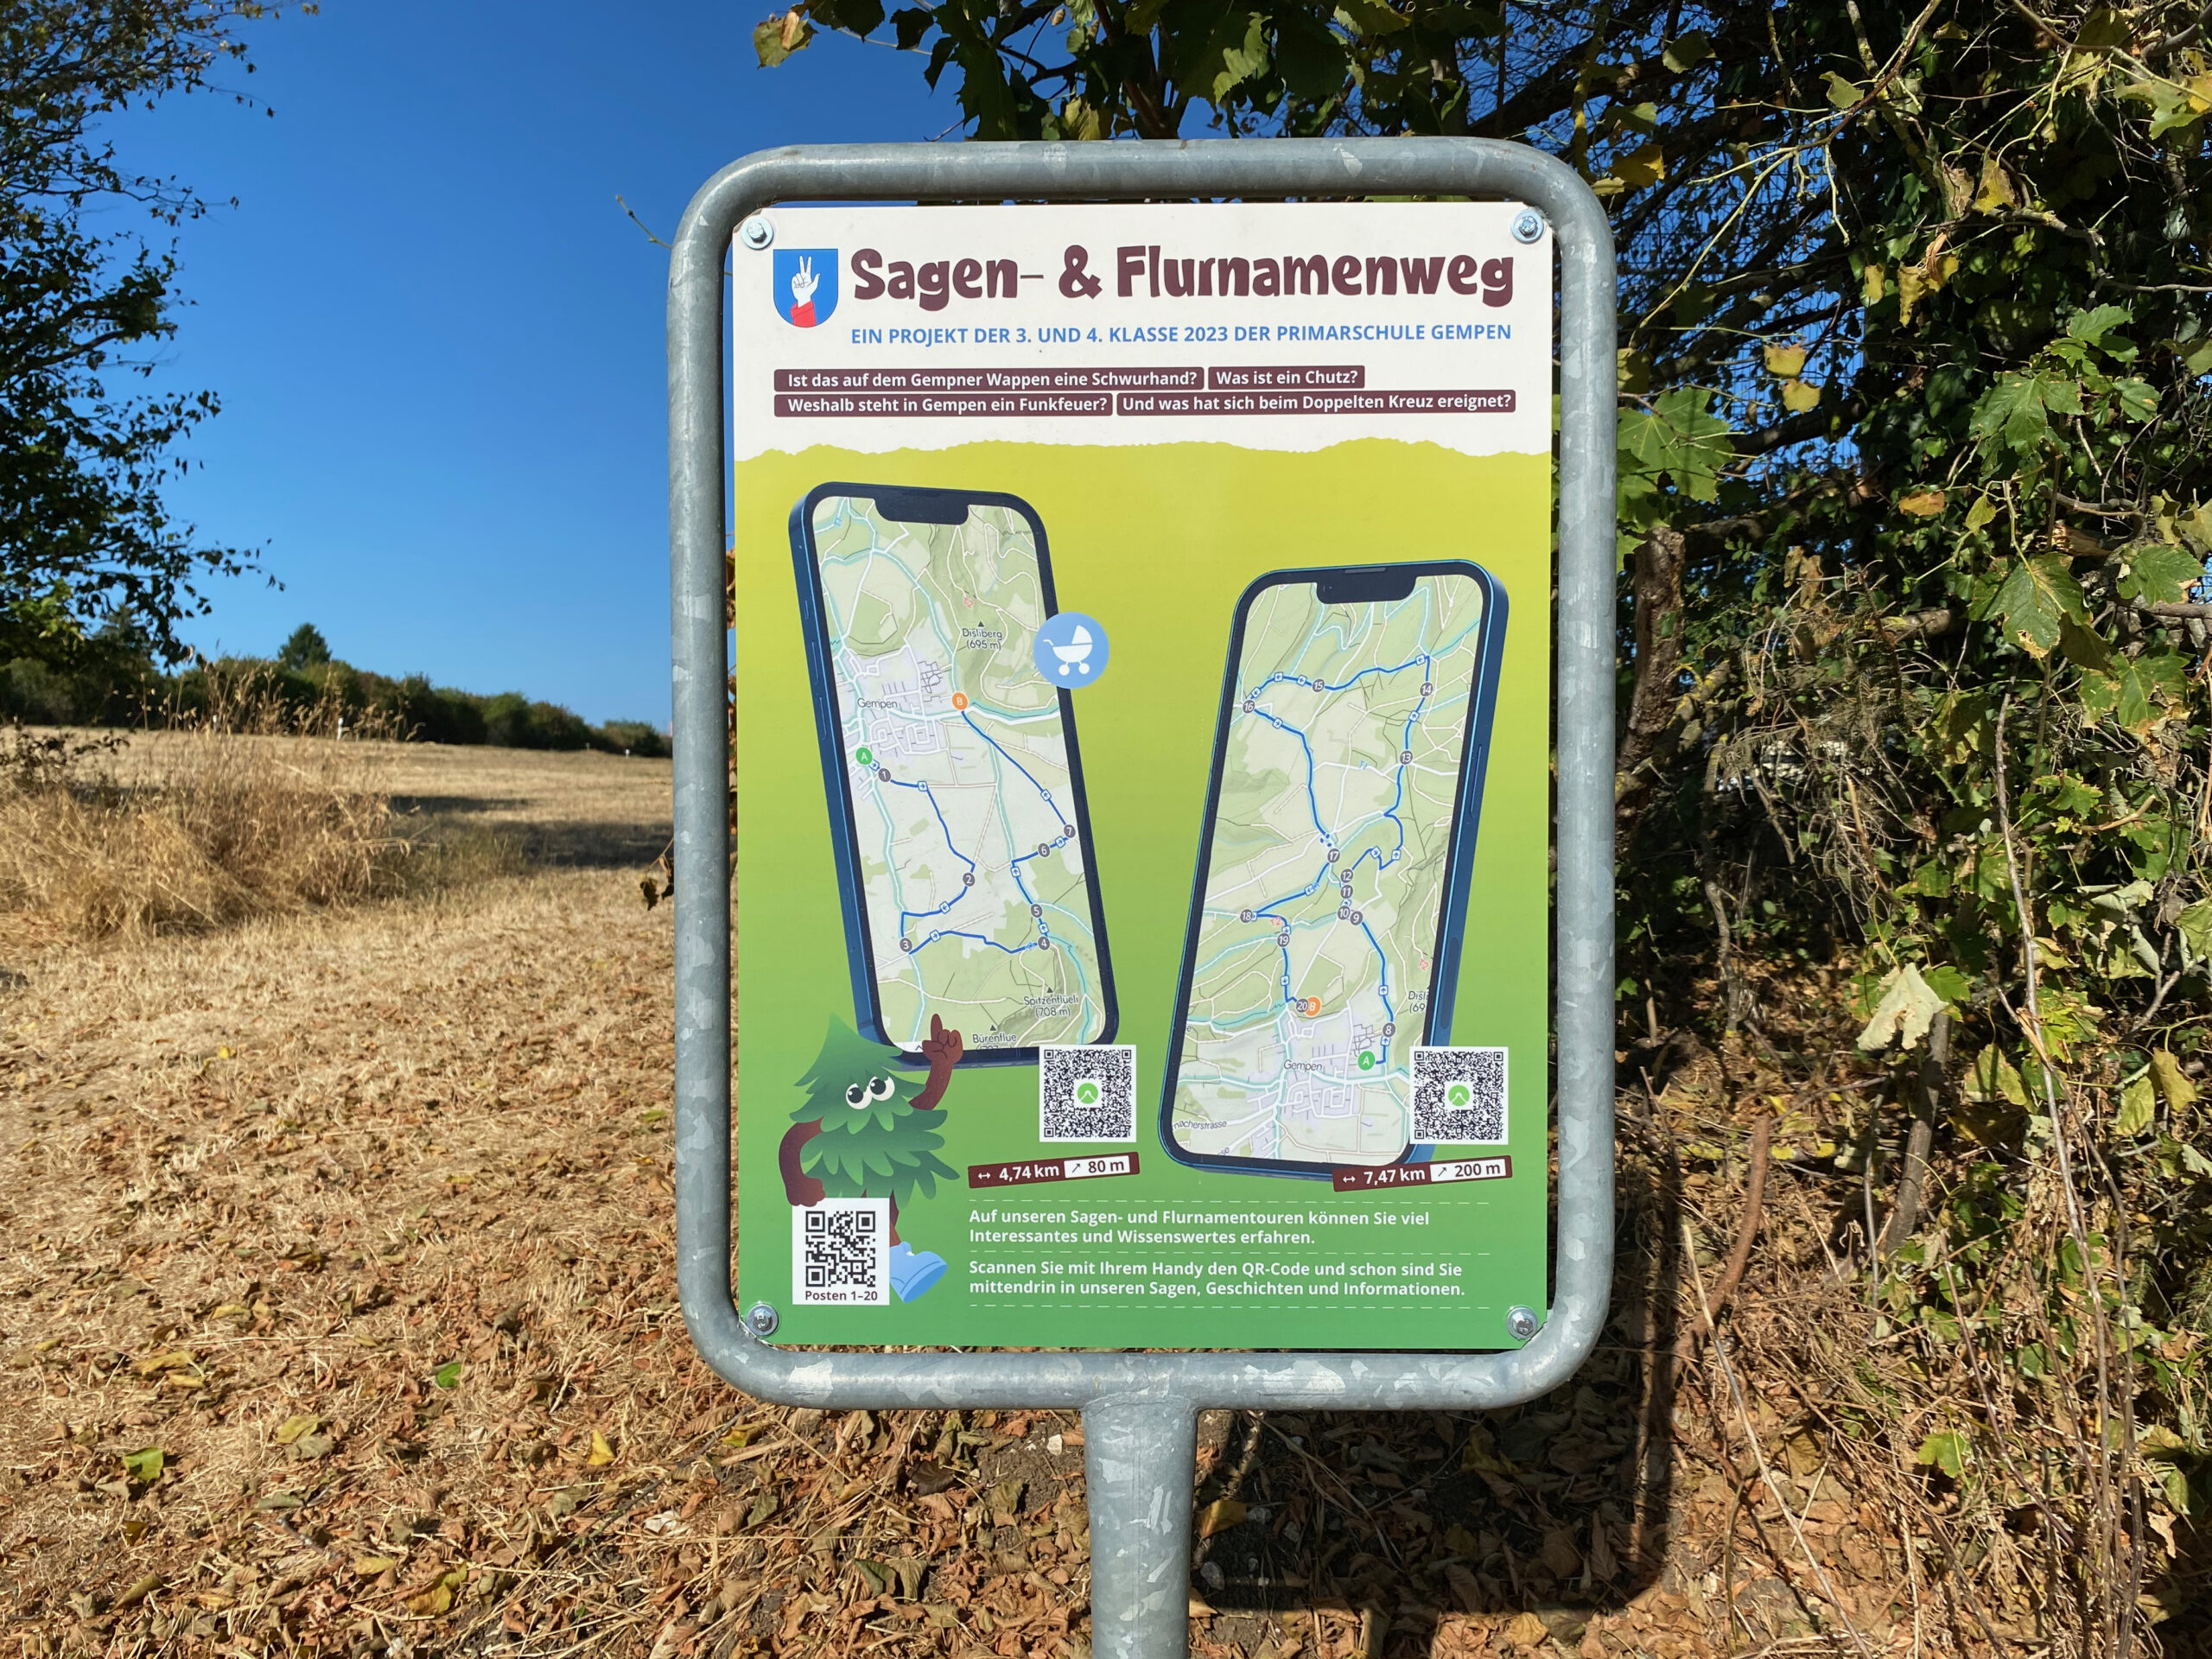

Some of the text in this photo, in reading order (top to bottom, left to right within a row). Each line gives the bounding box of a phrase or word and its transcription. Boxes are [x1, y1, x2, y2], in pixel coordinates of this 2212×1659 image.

[851, 245, 1514, 311] Sagen- & Flurnamenweg
[852, 324, 1510, 347] EIN PROJEKT DER 3. UND 4. KLASSE 2023 DER PRIMARSCHULE GEMPEN
[789, 372, 1197, 388] Ist das auf dem Gempner Wappen eine Schwurhand?
[1217, 370, 1357, 384] Was ist ein Chutz?
[788, 397, 1107, 415] Weshalb steht in Gempen ein Funkfeuer?
[1123, 393, 1511, 412] Und was hat sich beim Doppelten Kreuz ereignet?
[962, 628, 1002, 640] Disliberg
[967, 640, 1001, 652] (695 m)
[1314, 681, 1323, 690] 15
[1422, 685, 1432, 695] 14
[857, 697, 898, 709] Gempen
[1244, 702, 1254, 712] 16
[1402, 753, 1411, 763] 13
[1331, 851, 1339, 861] 17
[1343, 871, 1351, 881] 12
[1343, 887, 1351, 898] 11
[1243, 911, 1252, 921] 18
[1339, 908, 1349, 918] 10
[1279, 936, 1287, 945] 19
[1297, 1001, 1308, 1010] 20
[1035, 1007, 1071, 1018] (708 m)
[1283, 1059, 1322, 1071] Gempen
[1362, 1056, 1370, 1066] A
[999, 1160, 1124, 1182] 4,74 km 80 m
[1363, 1163, 1500, 1185] 7,47 km 200 m
[969, 1210, 1428, 1226] Auf unseren Sagen- und Flurnamentouren können Sie viel
[970, 1230, 1314, 1243] Interessantes und Wissenswertes erfahren.
[969, 1261, 1461, 1279] Scannen Sie mit Ihrem Handy den QR-Code und schon sind Sie
[970, 1280, 1465, 1298] mittendrin in unseren Sagen, Geschichten und Informationen.
[805, 1291, 846, 1300] Posten
